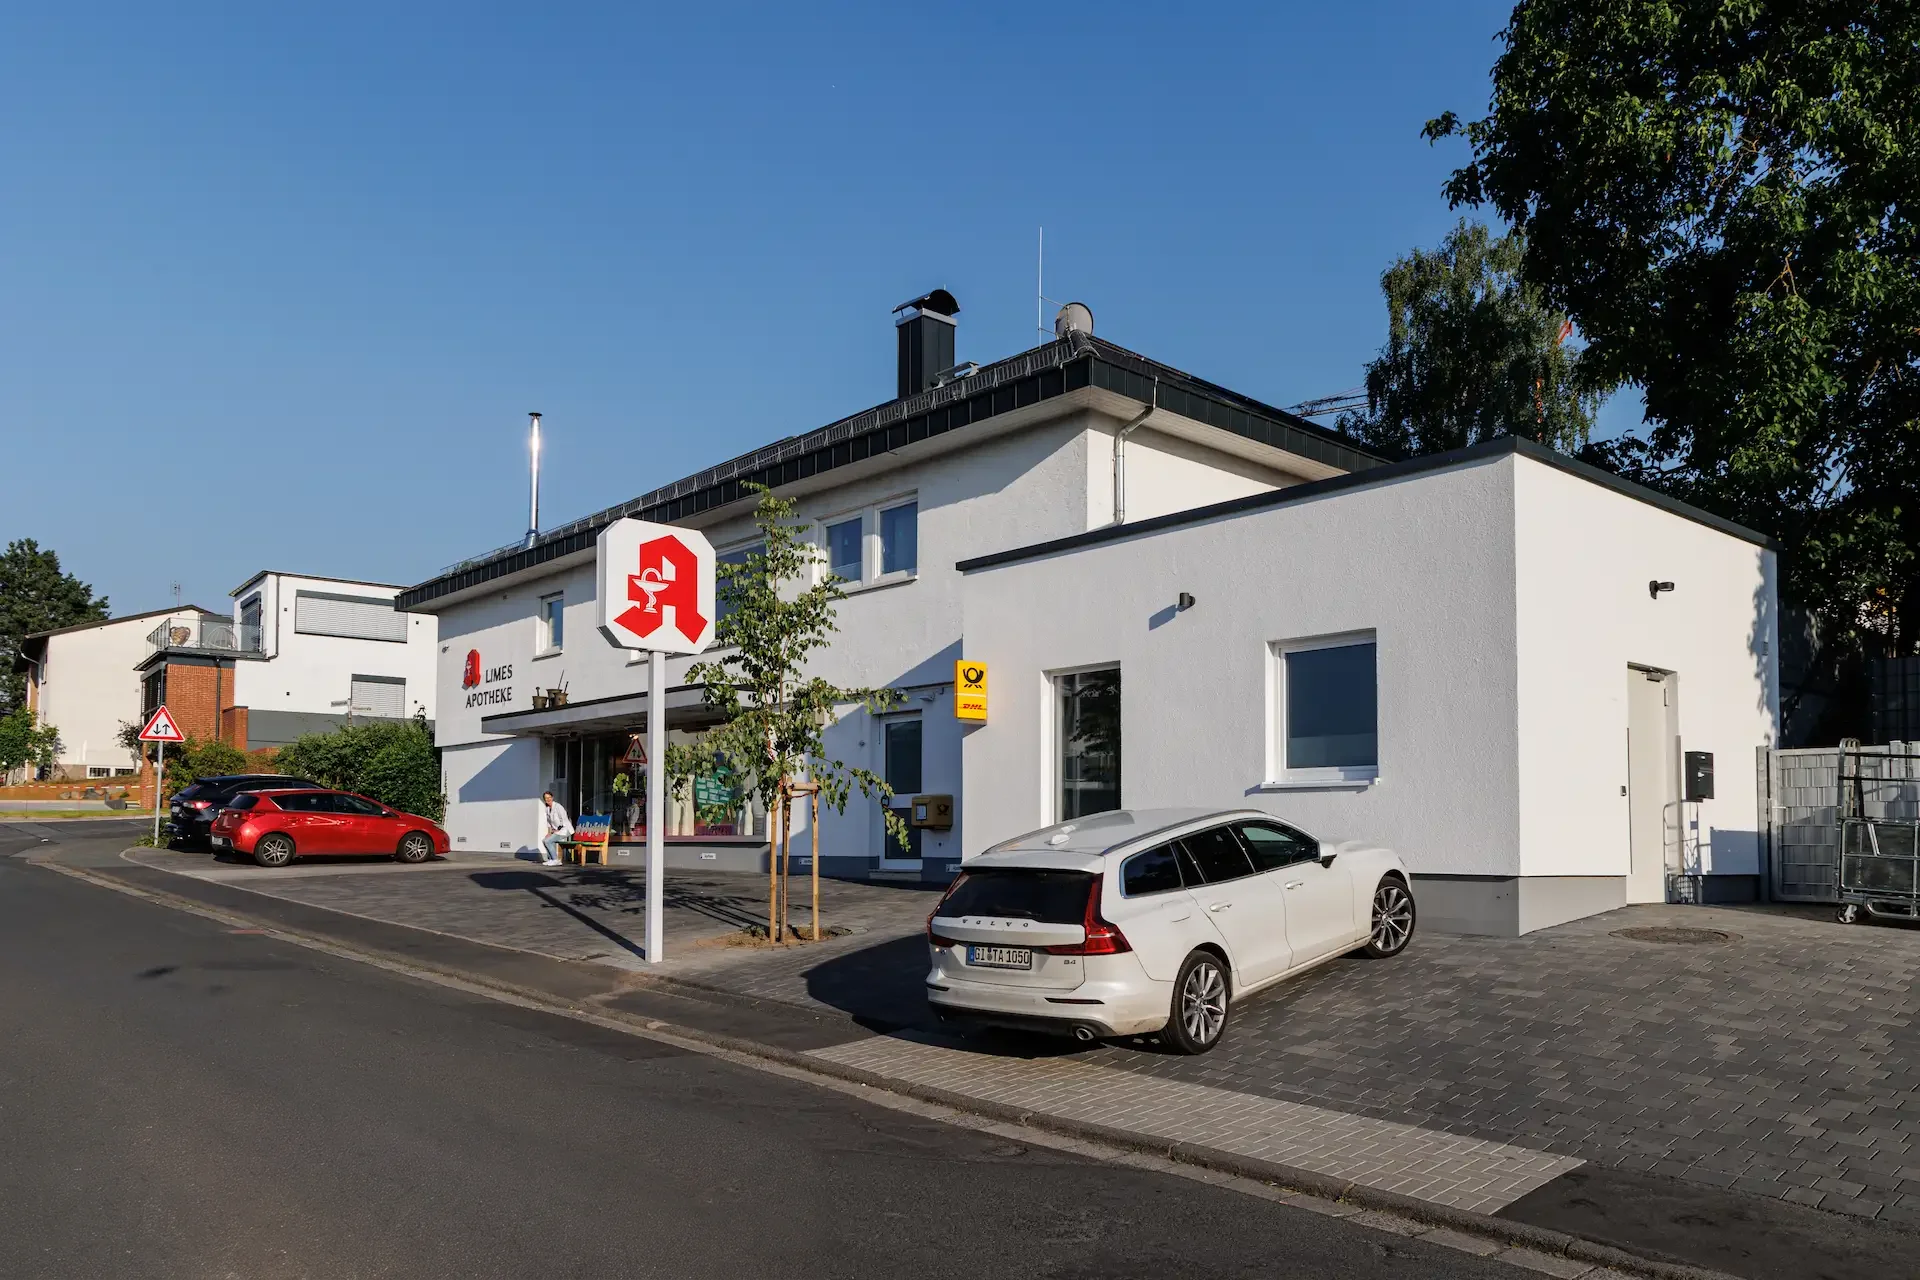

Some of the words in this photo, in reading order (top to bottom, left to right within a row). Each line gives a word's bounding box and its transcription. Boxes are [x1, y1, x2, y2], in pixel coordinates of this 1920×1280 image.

[485, 664, 513, 683] LIMES
[465, 686, 513, 708] APOTHEKE
[962, 919, 1029, 928] VOLVO
[975, 947, 985, 961] GI
[992, 949, 1004, 962] TA
[1006, 950, 1030, 964] 1050
